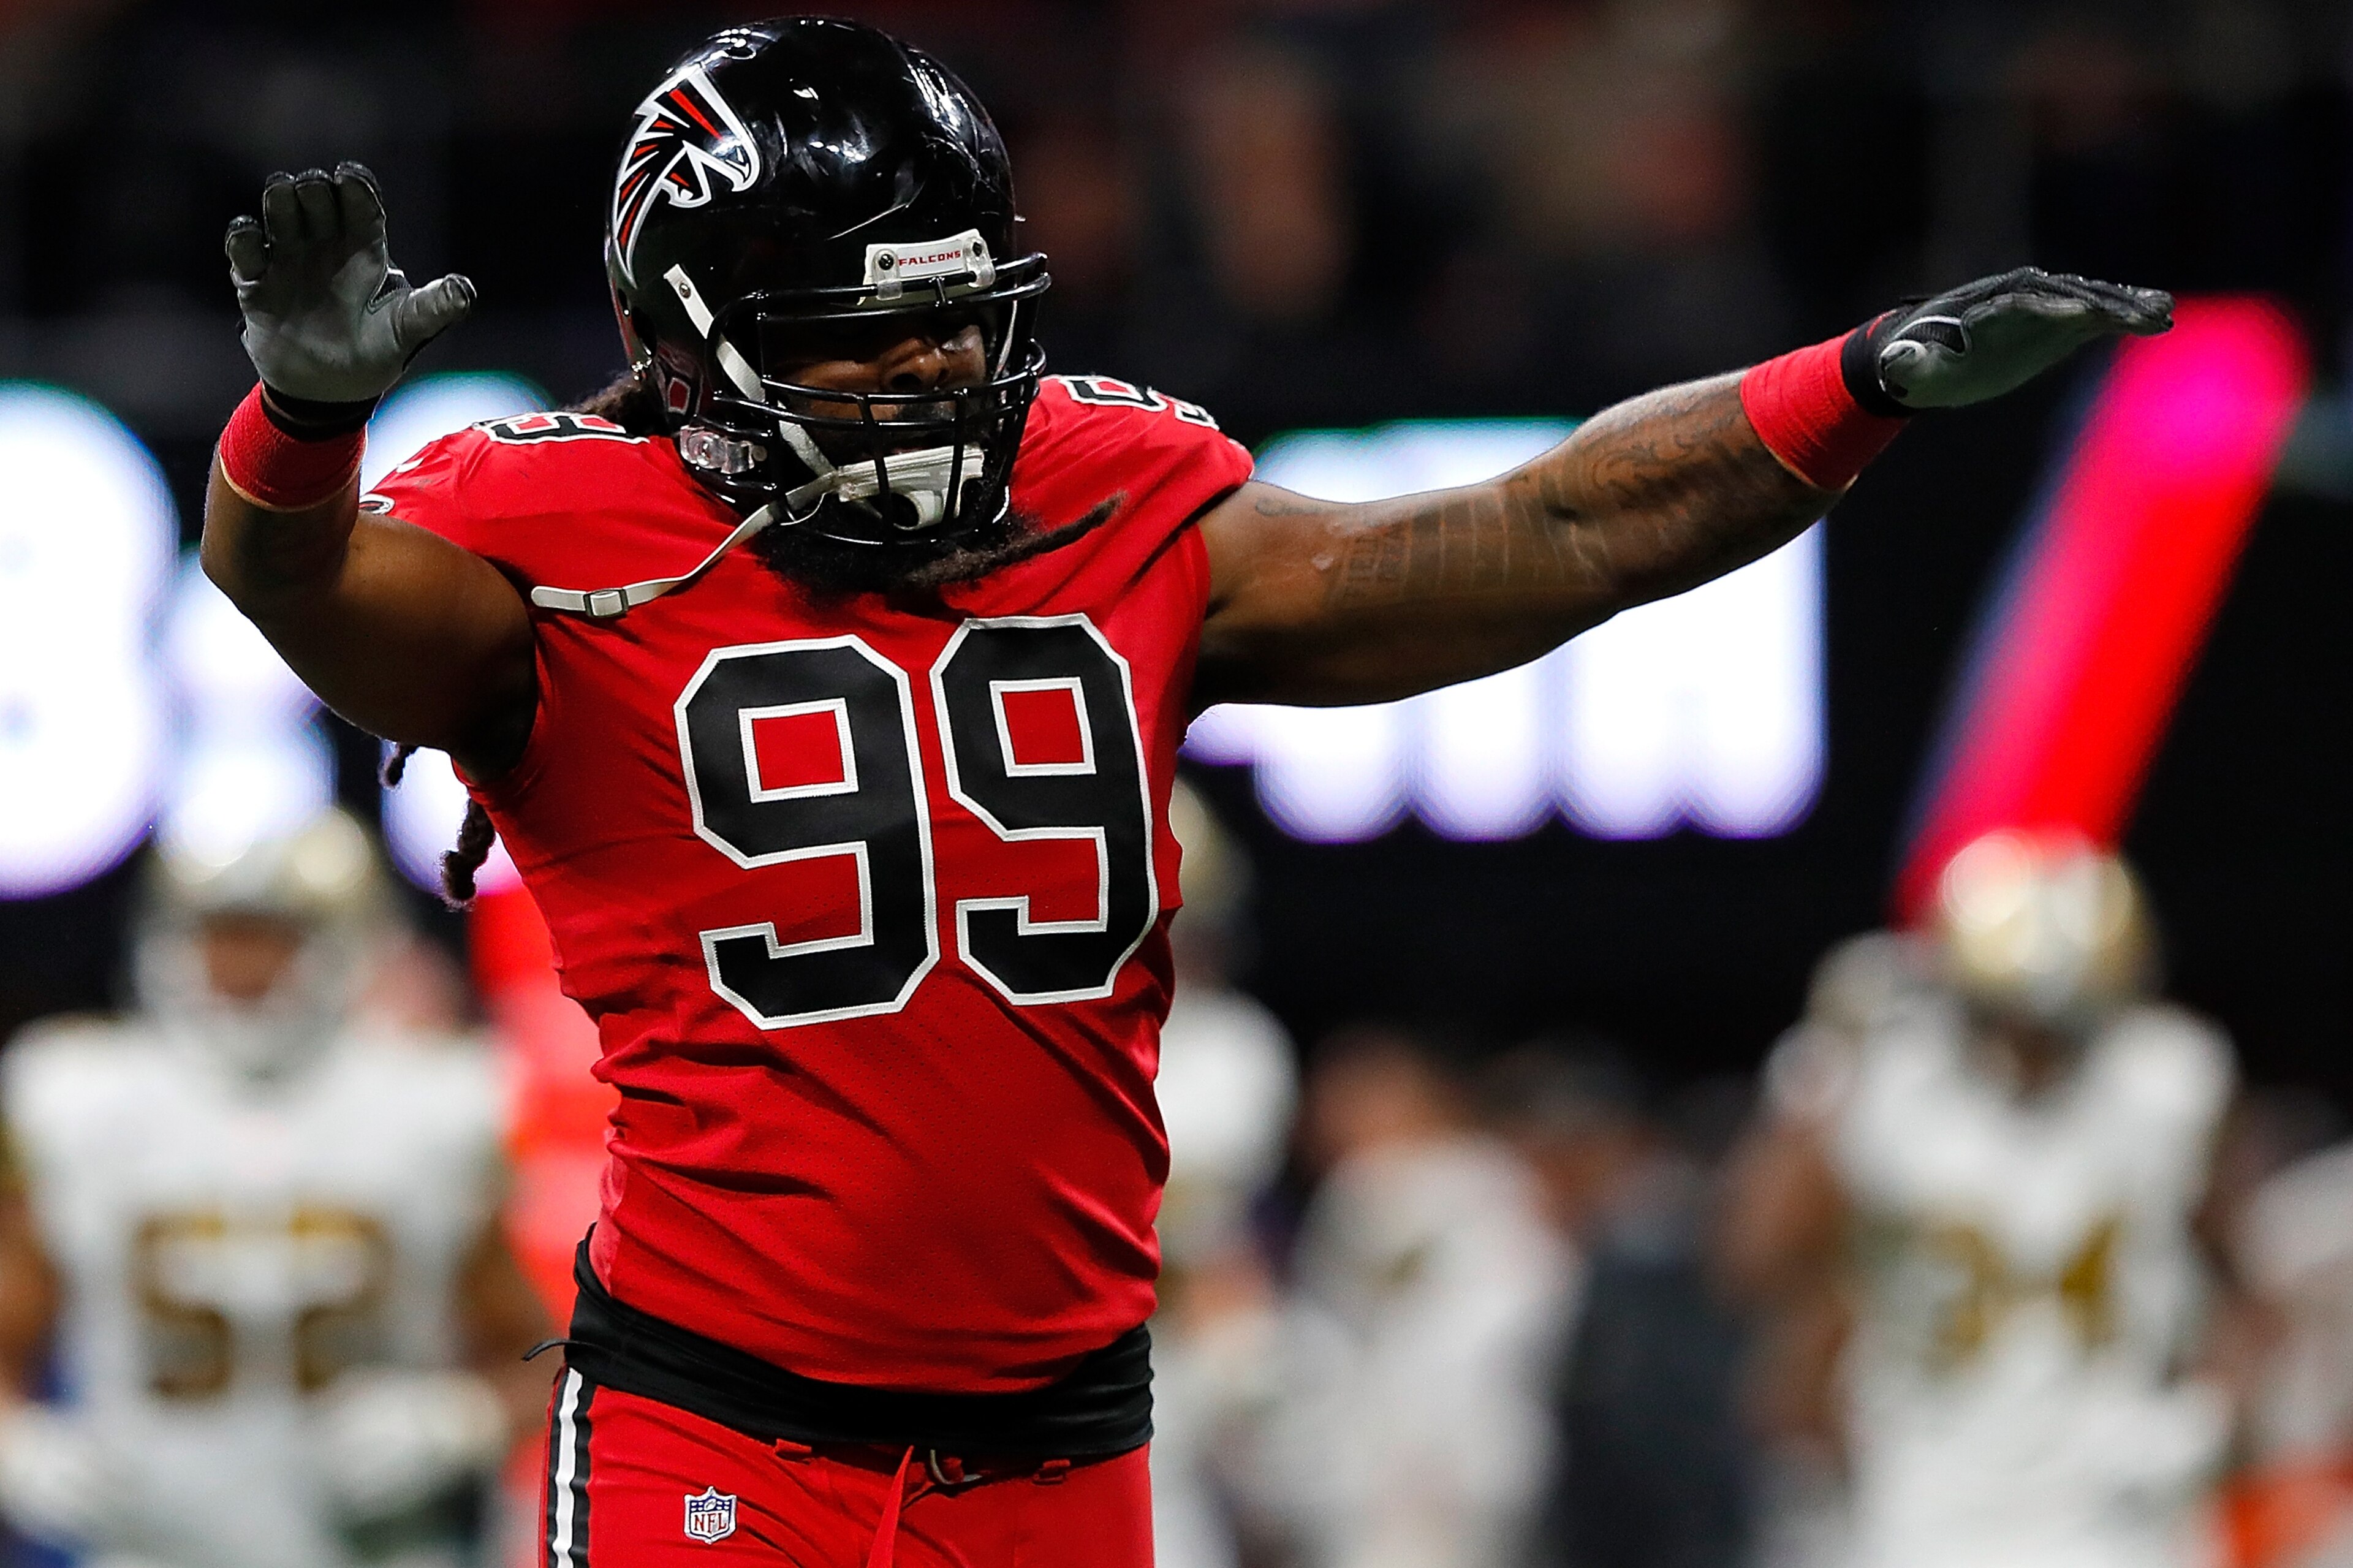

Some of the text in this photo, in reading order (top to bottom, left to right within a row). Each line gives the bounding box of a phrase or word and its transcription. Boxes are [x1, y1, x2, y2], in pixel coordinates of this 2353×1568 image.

[898, 250, 961, 267] FALCONS
[673, 613, 1159, 1031] 99
[694, 1512, 727, 1534] NFL
